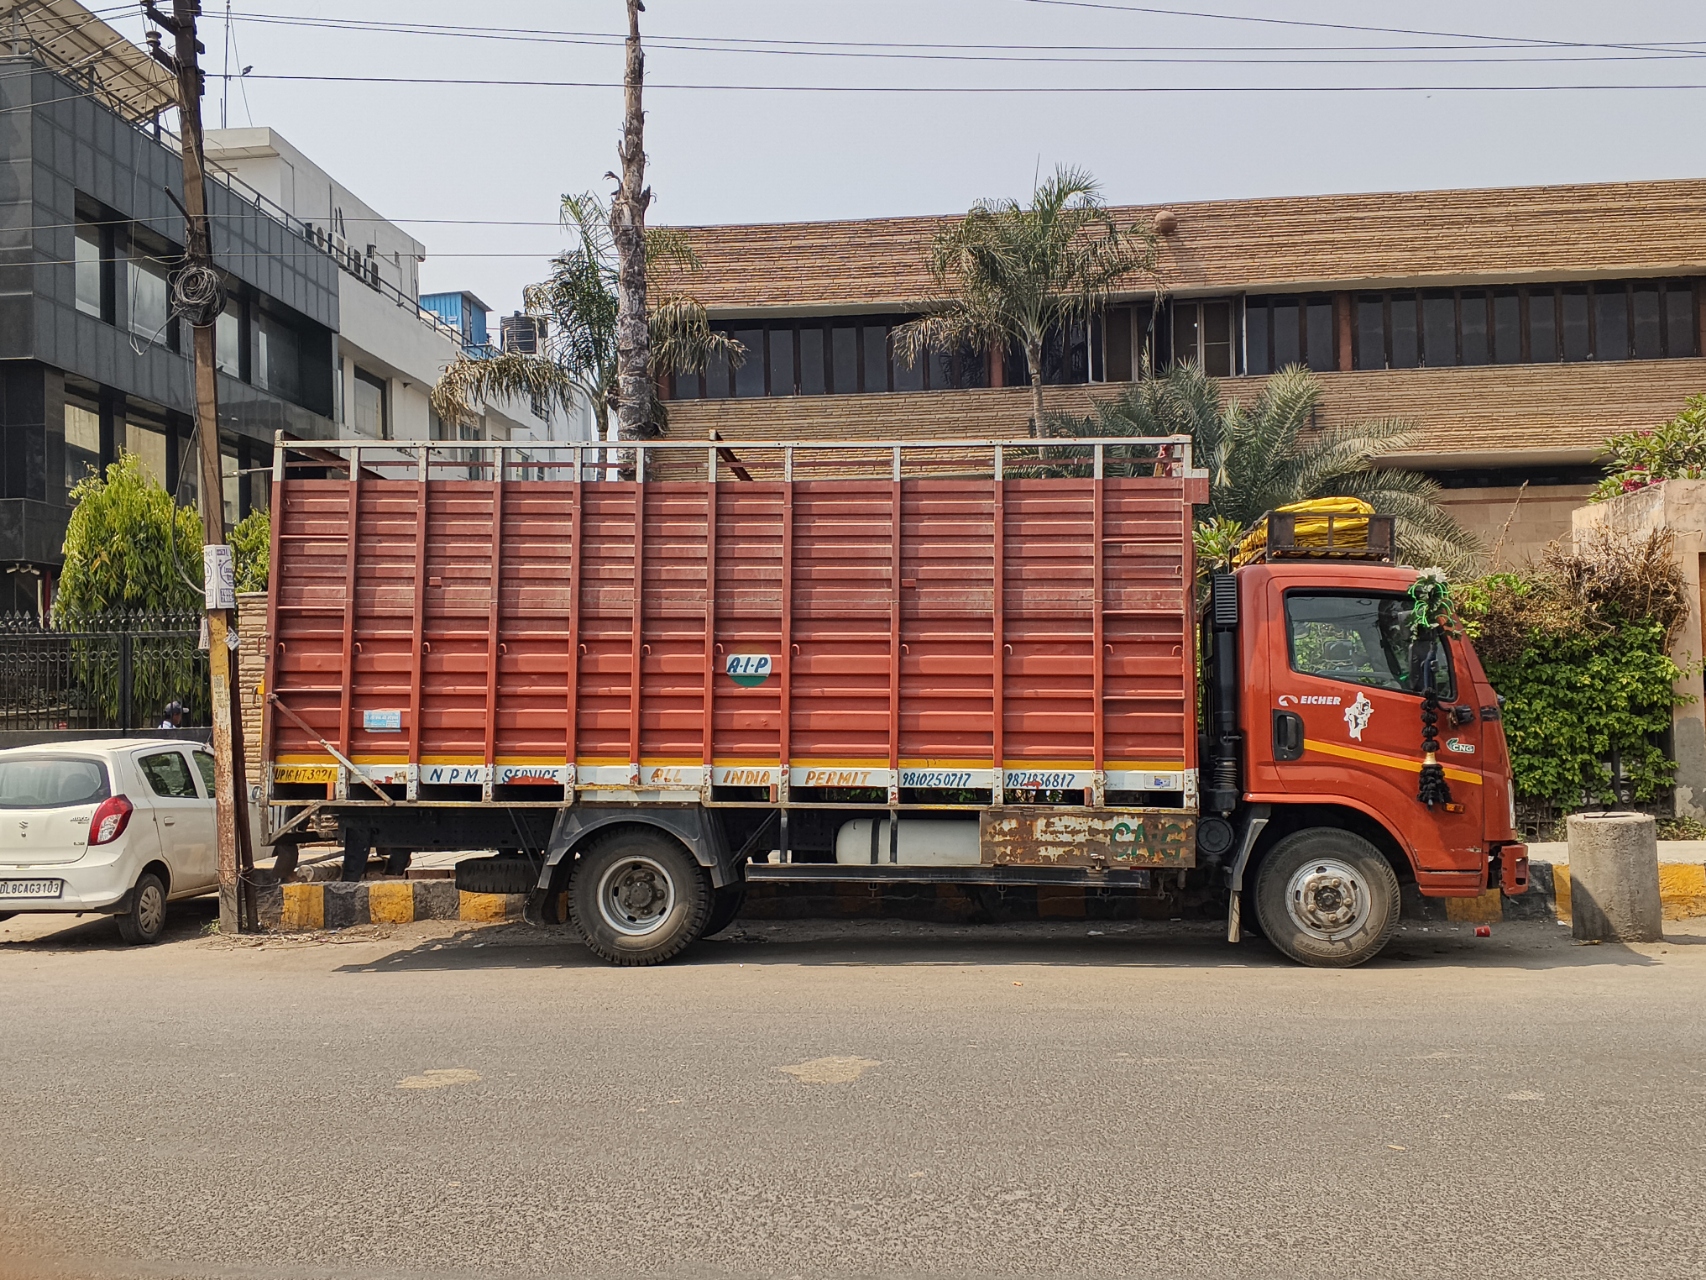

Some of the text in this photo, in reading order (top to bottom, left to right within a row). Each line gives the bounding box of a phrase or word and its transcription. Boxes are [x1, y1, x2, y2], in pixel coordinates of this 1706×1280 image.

[1300, 695, 1341, 705] EICHER
[1452, 744, 1474, 752] CNG
[651, 768, 872, 785] ALL INDIA PERMIT
[903, 772, 972, 788] 9810250717
[0, 883, 59, 894] DL8CAG3103
